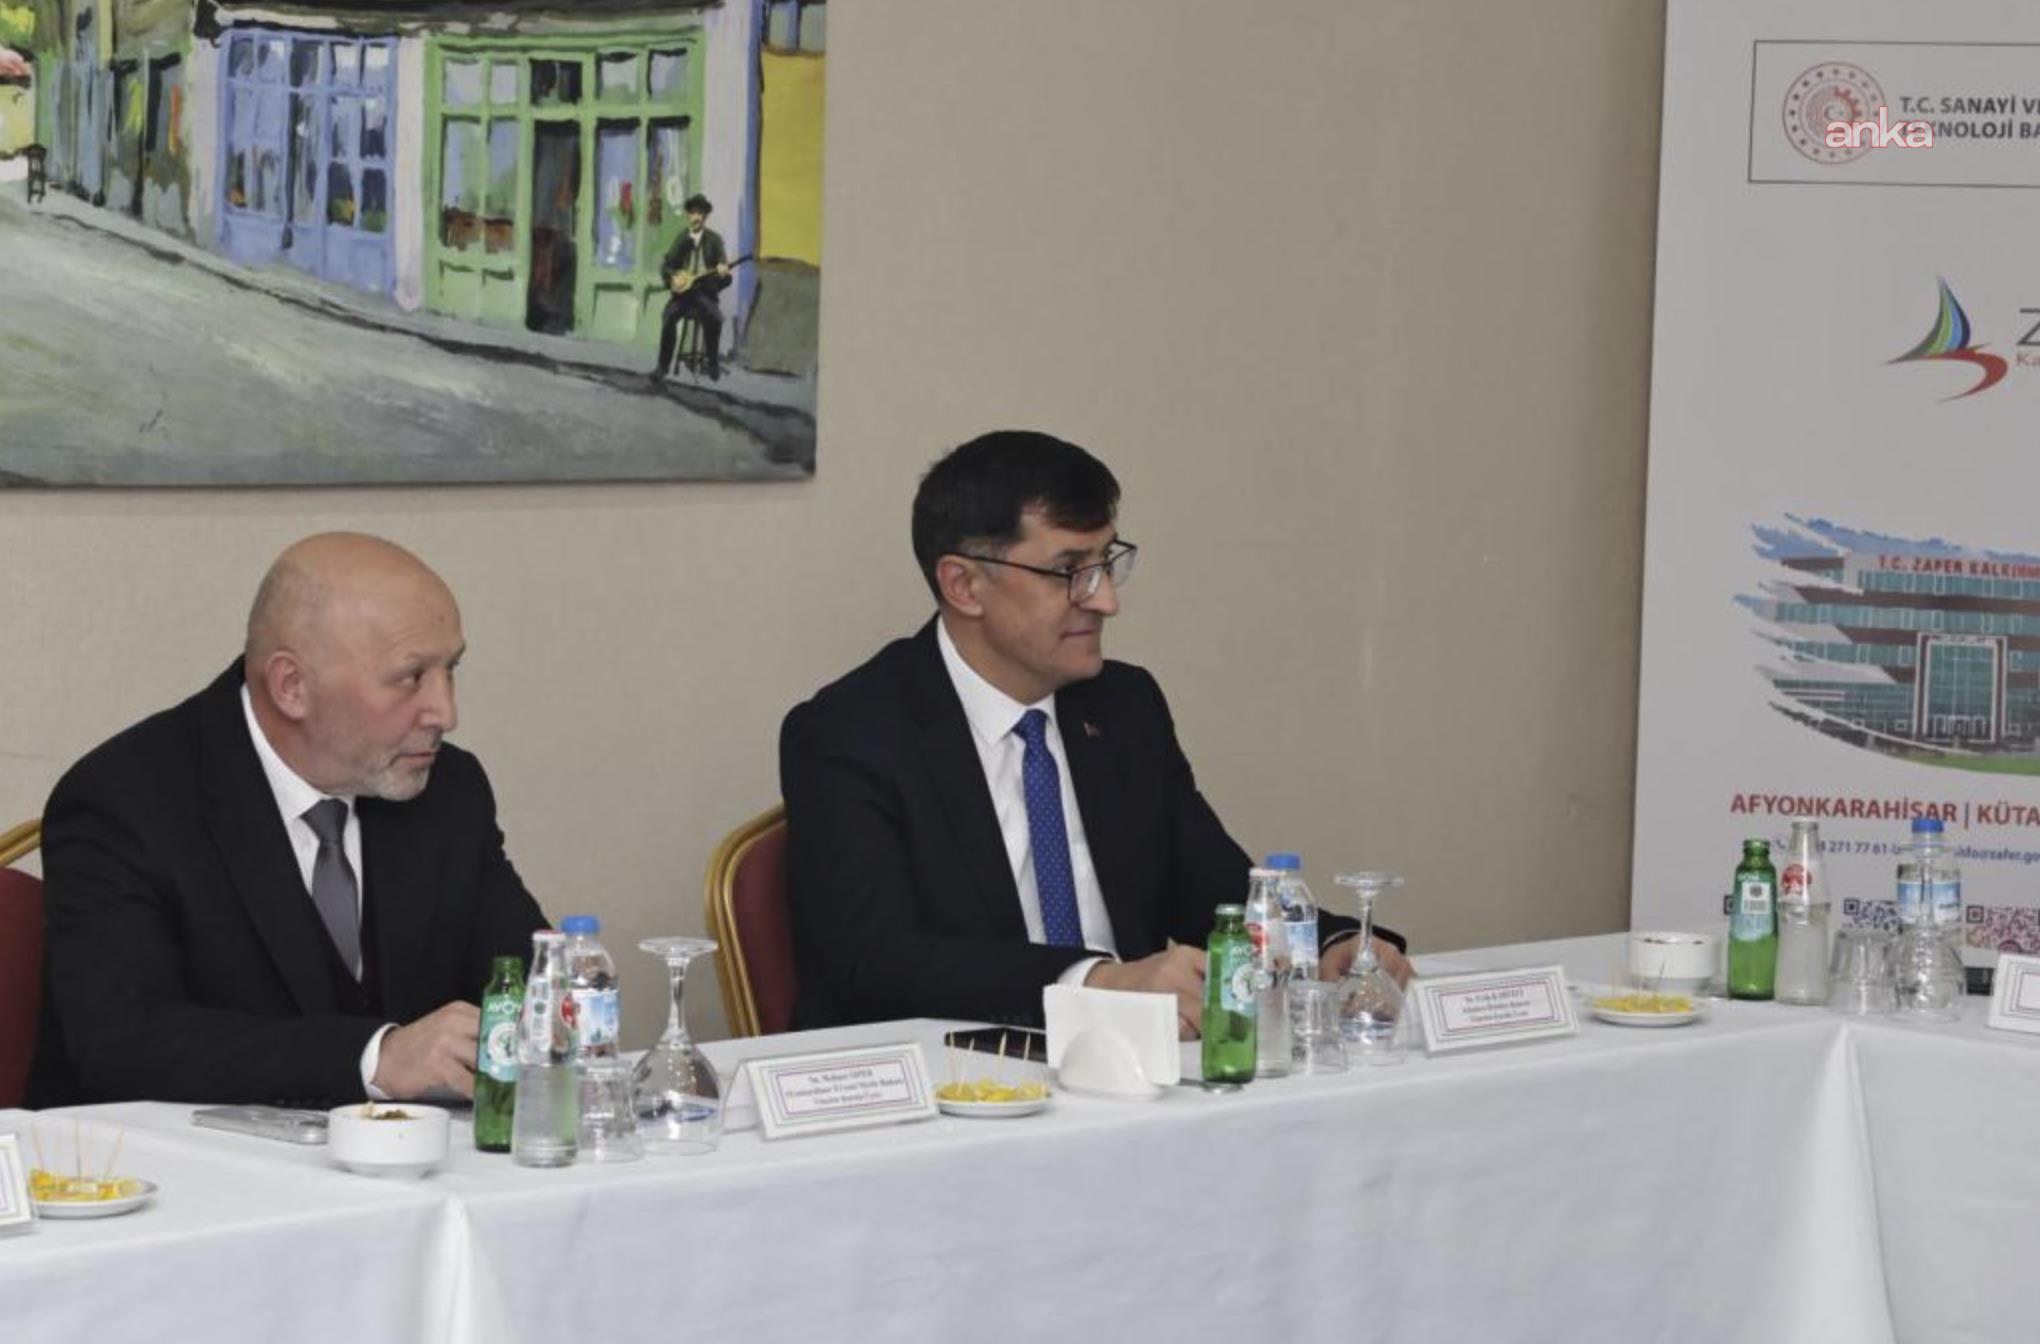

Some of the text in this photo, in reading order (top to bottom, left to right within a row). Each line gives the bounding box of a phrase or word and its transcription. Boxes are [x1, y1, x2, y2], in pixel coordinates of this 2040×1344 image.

[1900, 97, 1935, 114] T.C.
[1940, 94, 2016, 115] SANAYİ
[1731, 794, 1957, 822] AFYONKARAHİSAR
